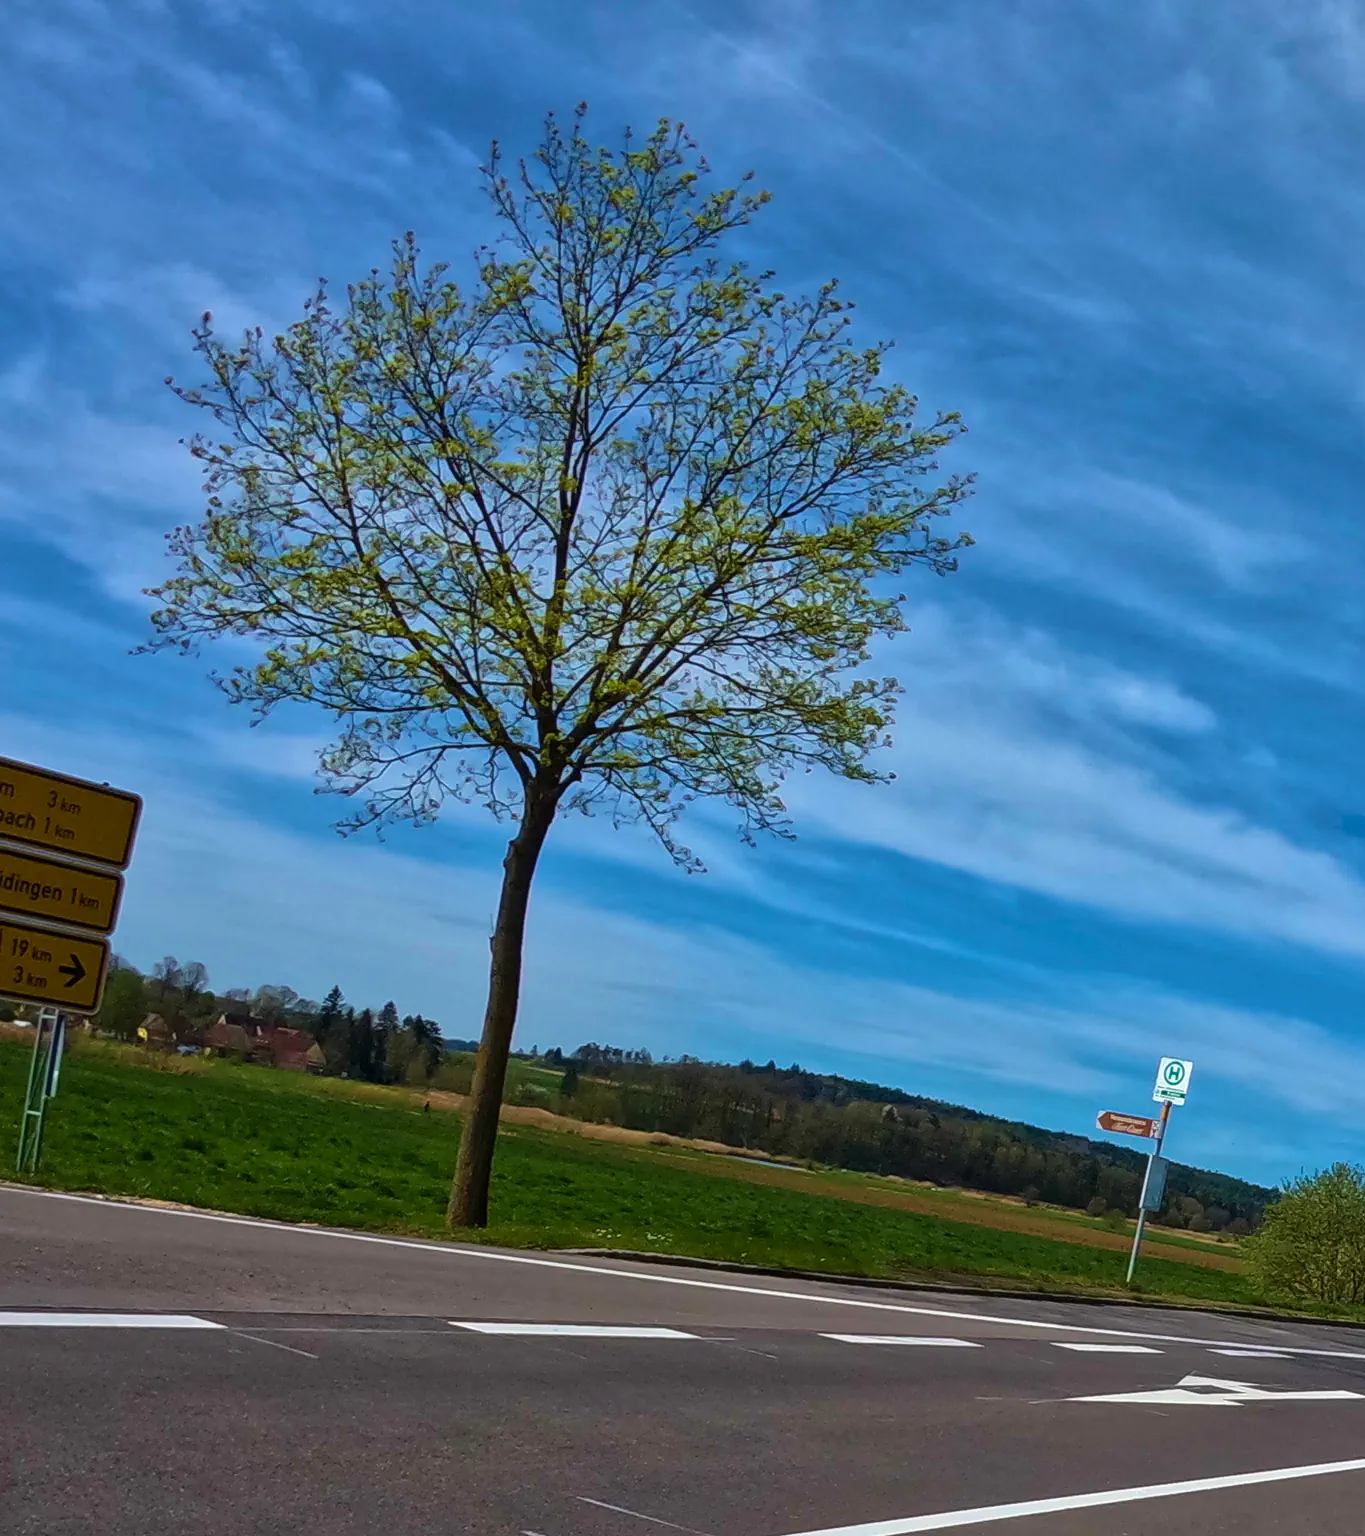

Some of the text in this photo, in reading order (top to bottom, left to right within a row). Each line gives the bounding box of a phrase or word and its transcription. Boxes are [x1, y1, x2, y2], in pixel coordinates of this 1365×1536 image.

[47, 790, 58, 808] 3
[60, 797, 81, 815] km
[44, 816, 51, 834] 1
[55, 824, 75, 841] km
[0, 871, 100, 909] dingen 1 km
[12, 937, 29, 957] 19
[32, 946, 52, 963] km
[13, 965, 48, 989] 3 km
